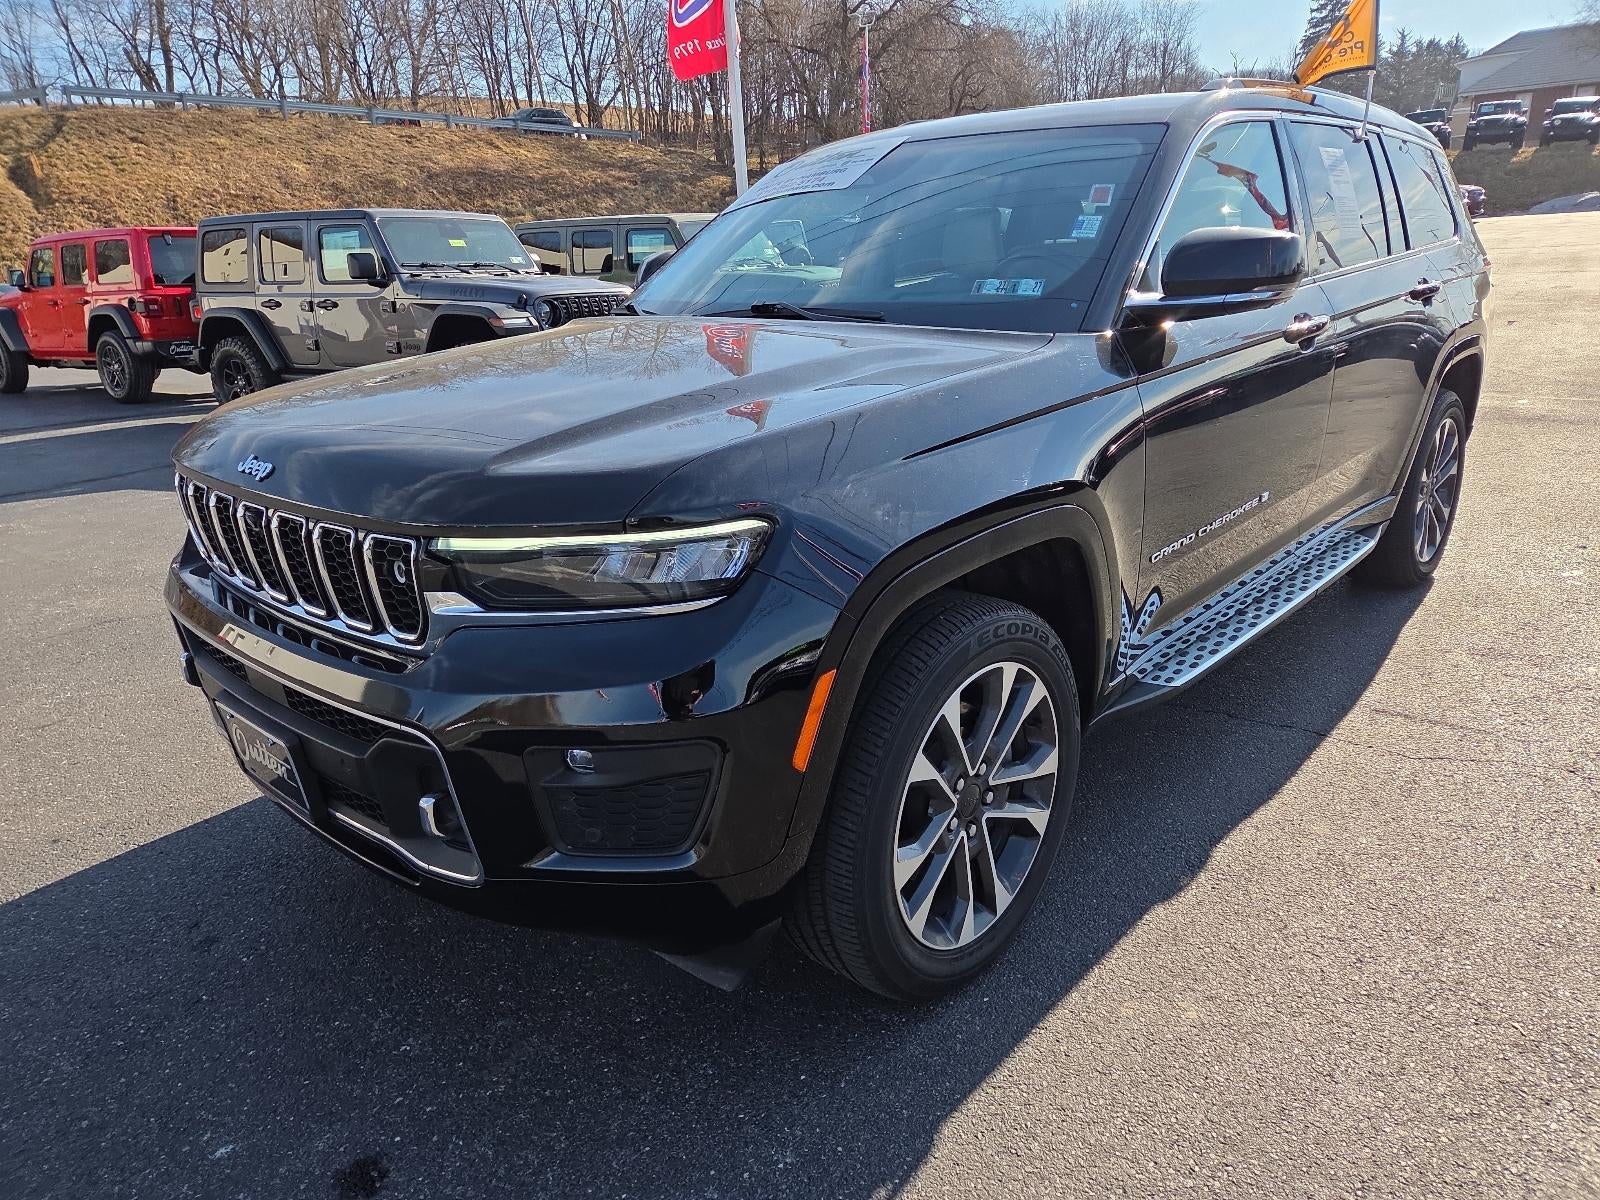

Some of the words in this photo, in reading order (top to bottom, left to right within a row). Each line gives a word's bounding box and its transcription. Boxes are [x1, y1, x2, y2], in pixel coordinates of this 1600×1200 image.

[1031, 281, 1044, 293] 27
[237, 454, 273, 481] Jeep
[1151, 532, 1196, 564] GRAND
[1198, 497, 1260, 537] CHEROKEE
